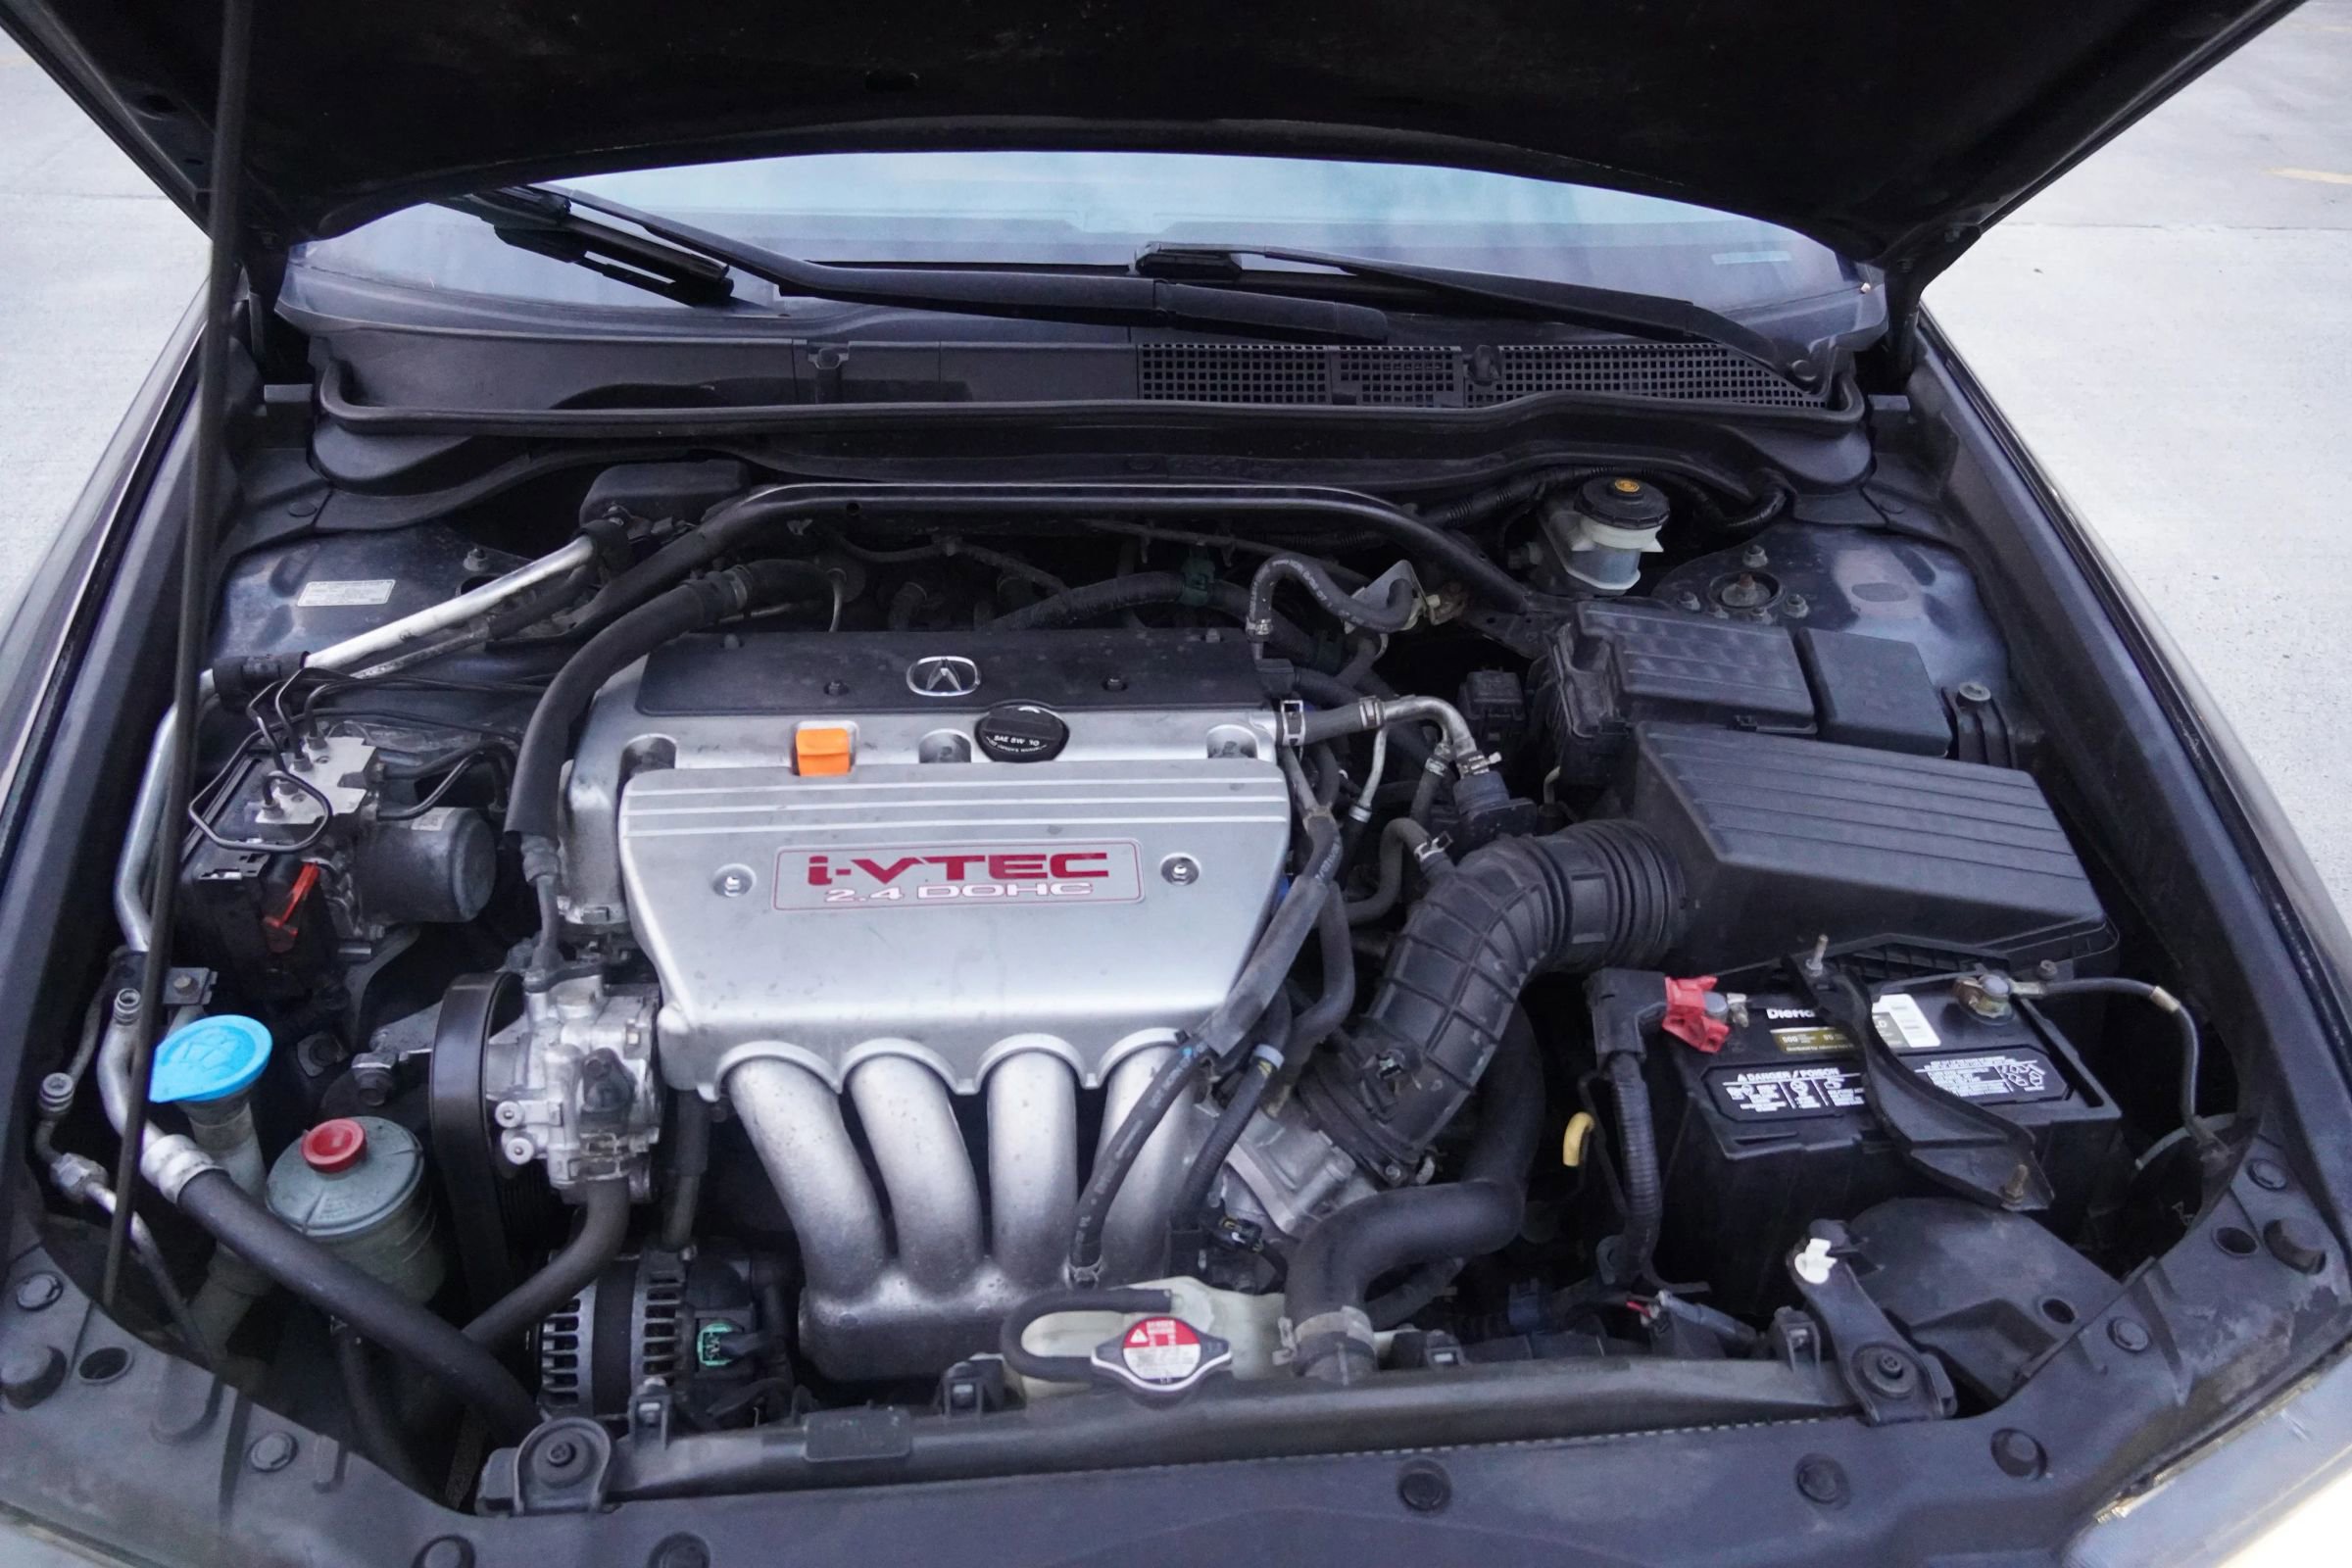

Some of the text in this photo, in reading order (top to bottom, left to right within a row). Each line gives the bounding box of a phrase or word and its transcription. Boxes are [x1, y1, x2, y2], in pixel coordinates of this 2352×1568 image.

[808, 853, 1109, 886] i-VTEC
[824, 882, 1093, 903] 2.4 DOHC
[1766, 1008, 1815, 1019] DieHa
[1745, 1071, 1791, 1081] DANGER
[1799, 1067, 1840, 1078] POISON
